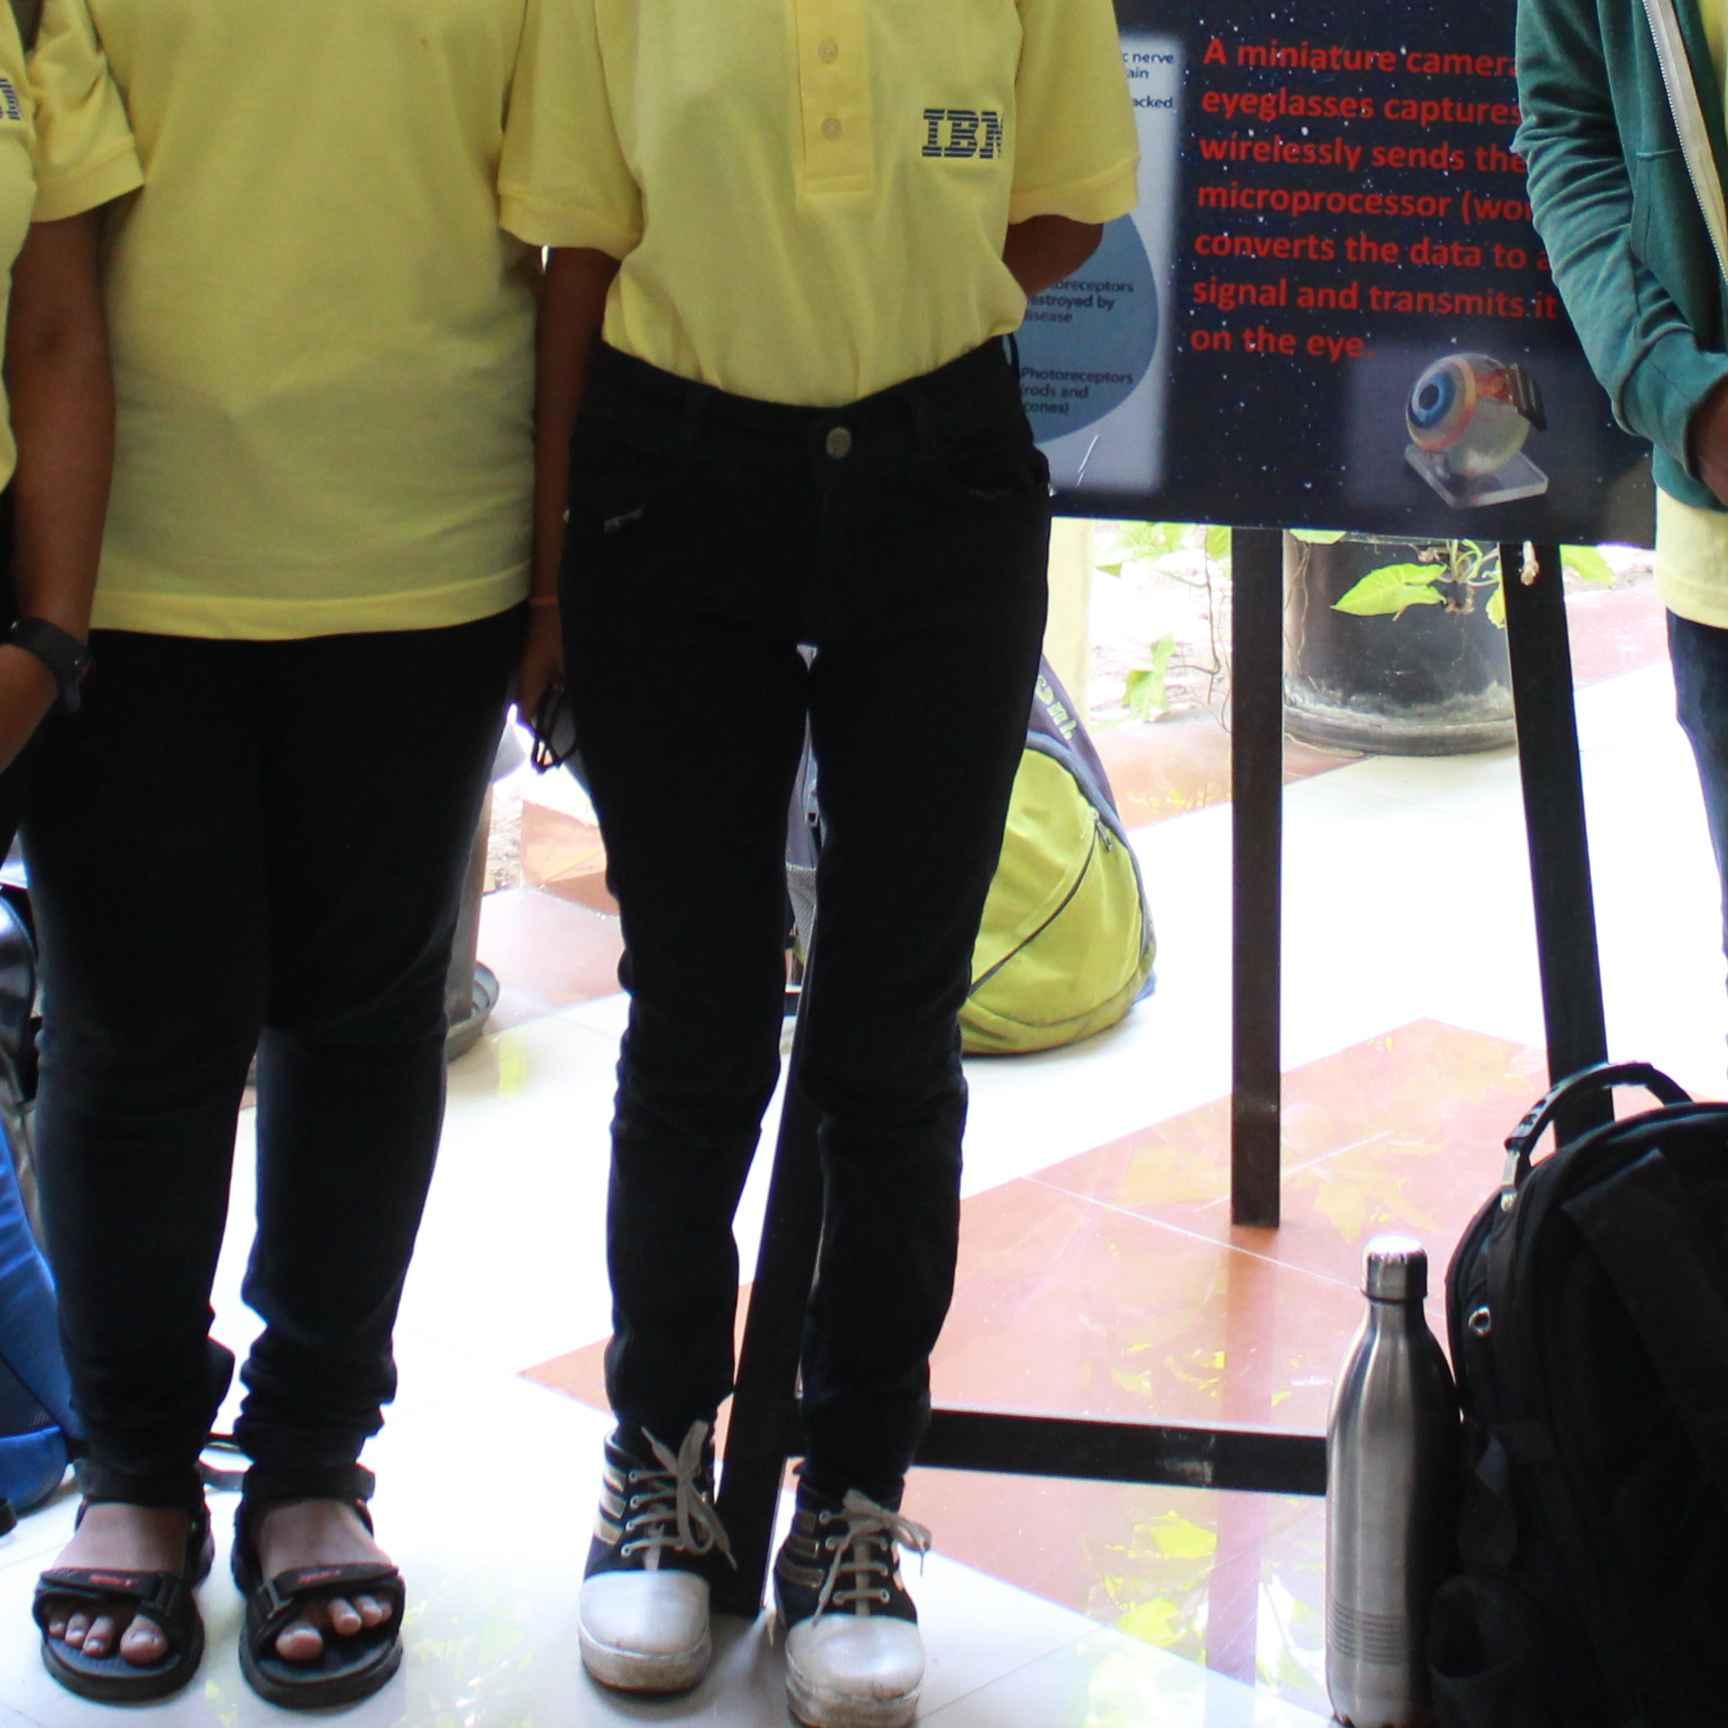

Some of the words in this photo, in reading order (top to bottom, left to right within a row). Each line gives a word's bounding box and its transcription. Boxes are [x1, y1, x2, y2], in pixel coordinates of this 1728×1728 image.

[1203, 38, 1228, 66] A
[1237, 39, 1396, 71] miniature
[1201, 86, 1375, 121] eyeglasses
[1383, 96, 1523, 127] captures
[1200, 132, 1363, 171] wirelessly
[1372, 140, 1465, 172] sends
[1197, 180, 1452, 218] microprocessor
[1194, 232, 1336, 261] converts
[1344, 234, 1400, 263] the
[1410, 236, 1483, 268] data
[1493, 242, 1527, 270] to
[1192, 276, 1288, 311] signal
[1296, 280, 1360, 310] and
[1369, 285, 1524, 319] transmits
[1534, 289, 1559, 320] it
[1190, 328, 1233, 351] on
[1241, 325, 1297, 354] the
